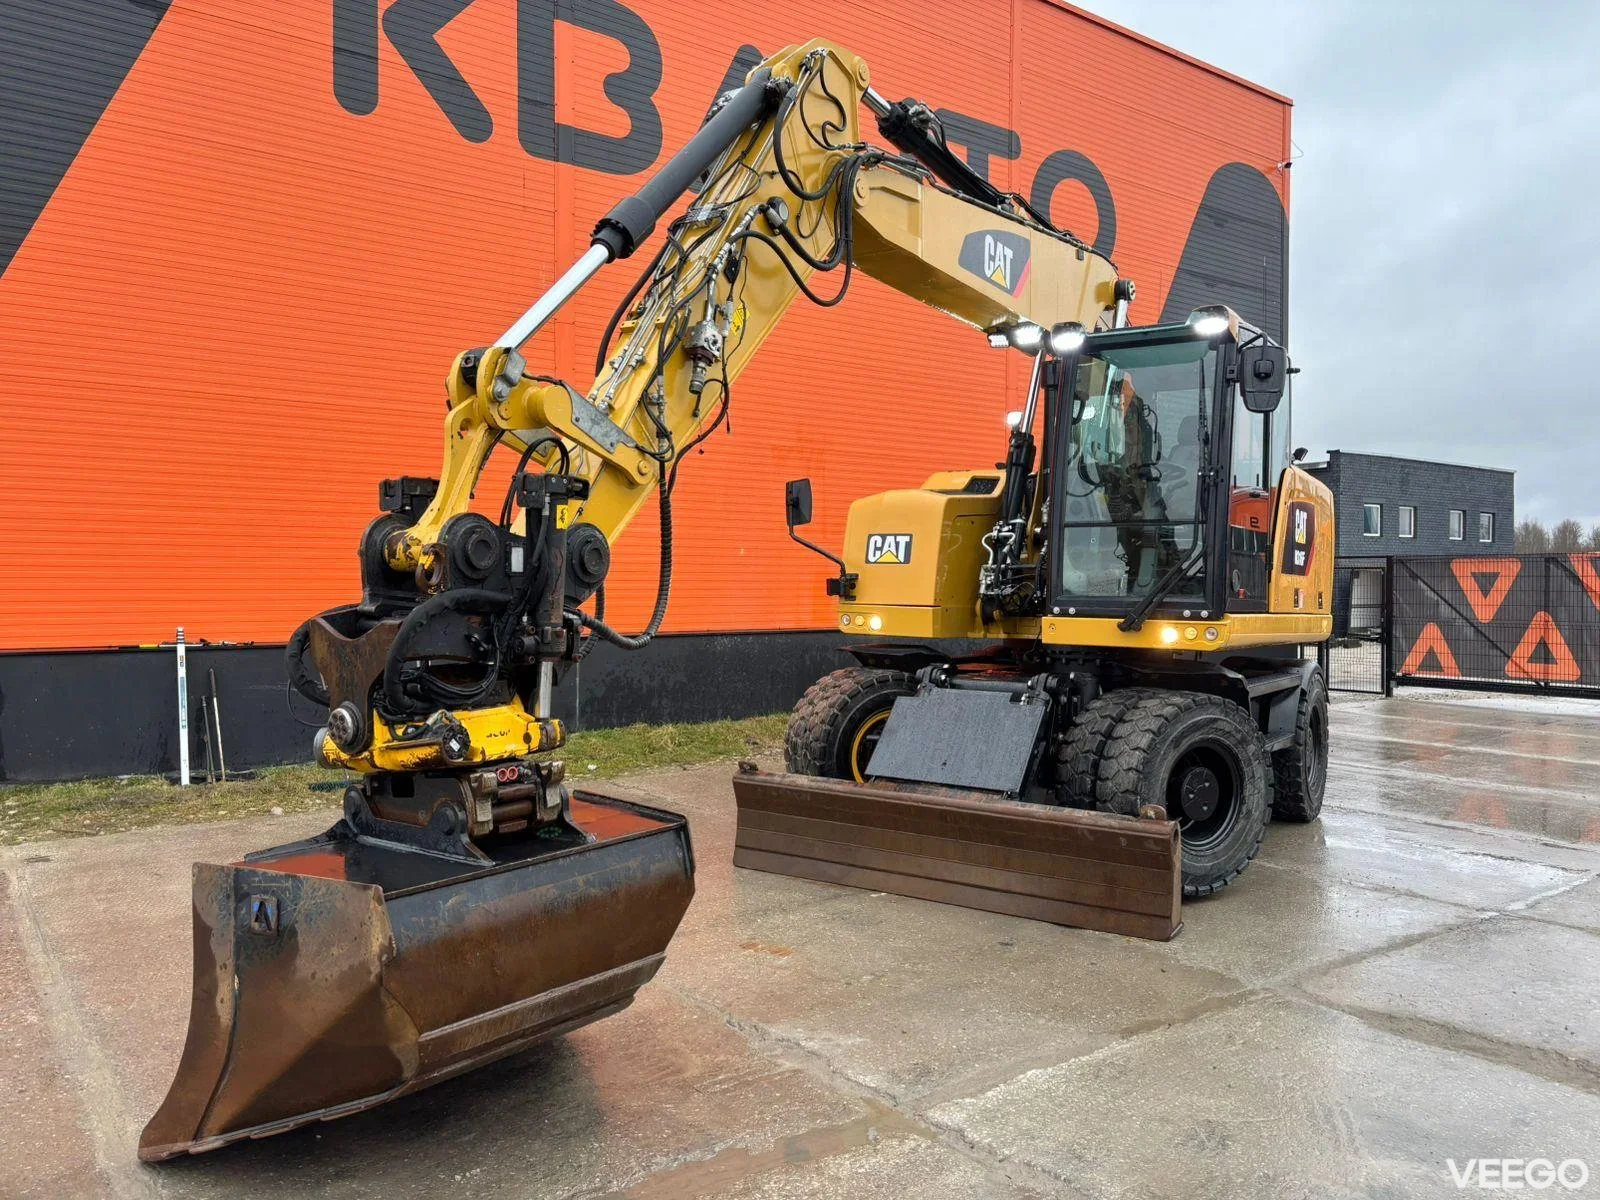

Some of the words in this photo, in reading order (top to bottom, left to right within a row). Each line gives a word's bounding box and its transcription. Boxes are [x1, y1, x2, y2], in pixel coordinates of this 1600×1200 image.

[984, 234, 1013, 290] CAT
[1295, 509, 1308, 545] CAT
[868, 535, 910, 563] CAT
